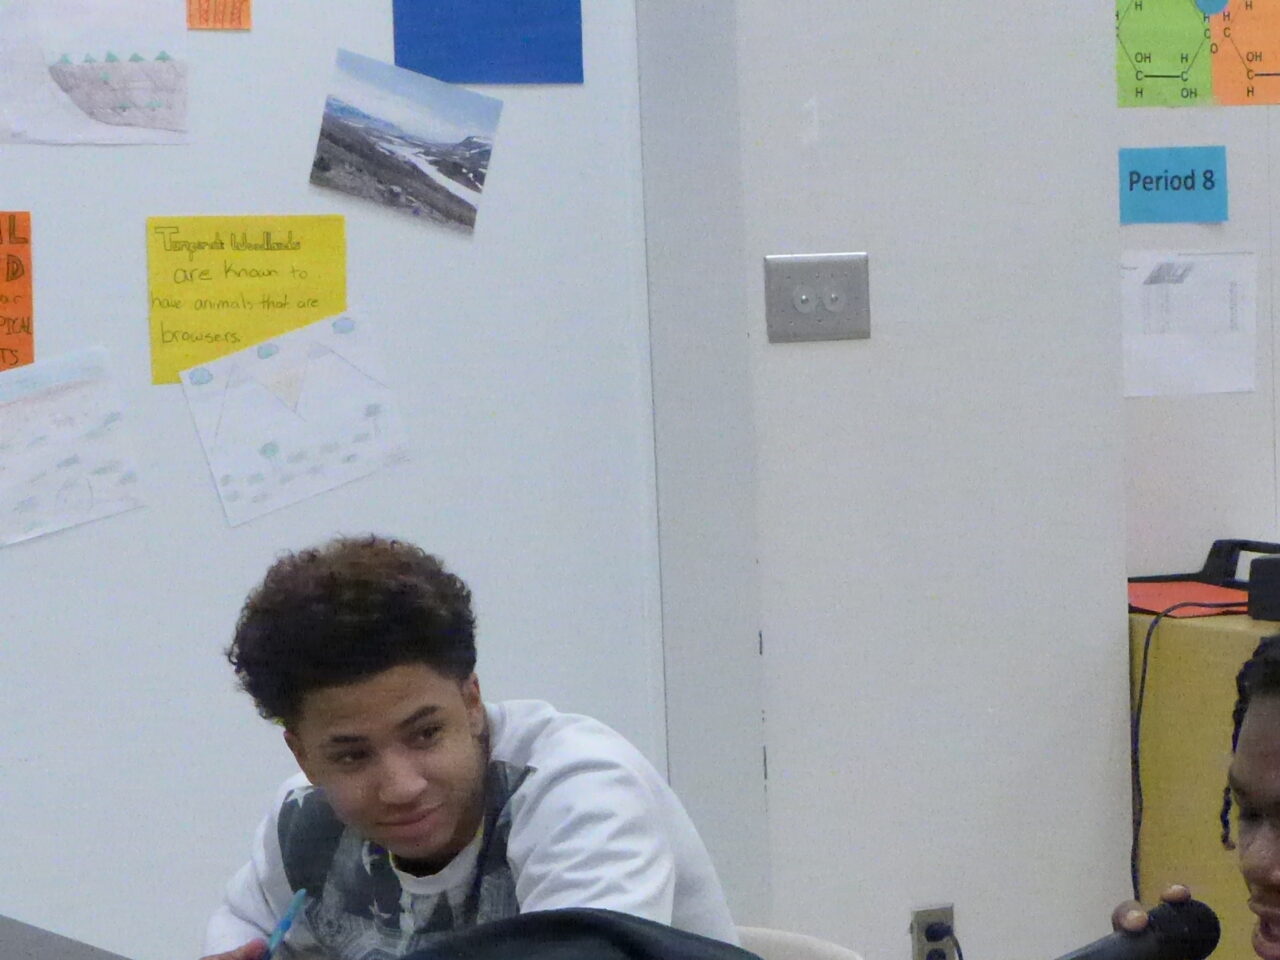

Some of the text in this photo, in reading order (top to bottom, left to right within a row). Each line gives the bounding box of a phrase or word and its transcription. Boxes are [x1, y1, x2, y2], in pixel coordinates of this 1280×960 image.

[1135, 1, 1142, 10] H
[1246, 1, 1252, 9] H
[1204, 14, 1210, 22] H
[1223, 12, 1230, 21] H
[1204, 29, 1210, 38] C
[1224, 27, 1230, 37] C
[1210, 43, 1218, 53] O
[1135, 54, 1151, 63] OH
[1181, 54, 1188, 63] H
[1247, 52, 1262, 61] OH
[1136, 72, 1143, 80] C
[1181, 72, 1188, 81] C
[1247, 70, 1254, 80] C
[1136, 88, 1143, 97] H
[1181, 88, 1197, 98] OH
[1247, 87, 1254, 96] H
[1129, 169, 1215, 191] Period 8
[174, 268, 212, 284] are
[291, 266, 308, 280] to
[151, 293, 320, 310] have animals that are
